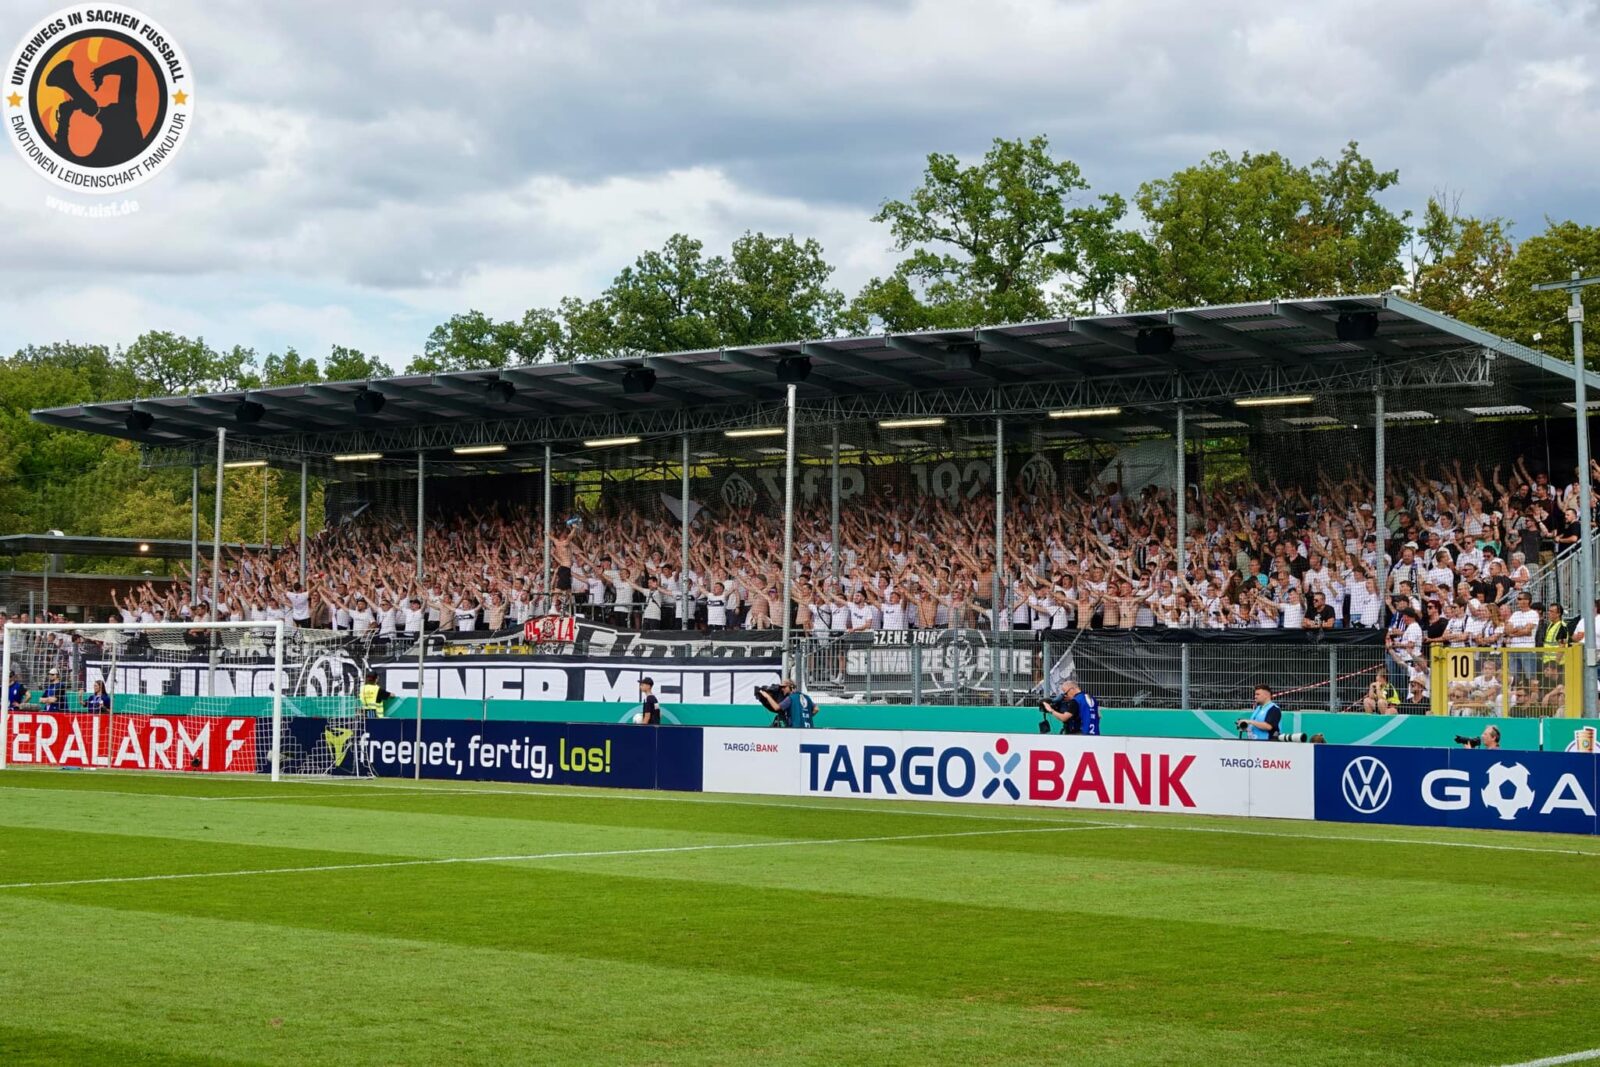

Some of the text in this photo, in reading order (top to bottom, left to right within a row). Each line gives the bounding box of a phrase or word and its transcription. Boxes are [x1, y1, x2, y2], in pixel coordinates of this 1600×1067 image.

[873, 630, 908, 645] SZENE
[846, 649, 944, 675] SCHWAZE
[976, 647, 1032, 675] EITE
[1451, 655, 1469, 678] 10
[7, 714, 210, 770] ERALARM
[360, 733, 612, 779] freenet, fertig, los!
